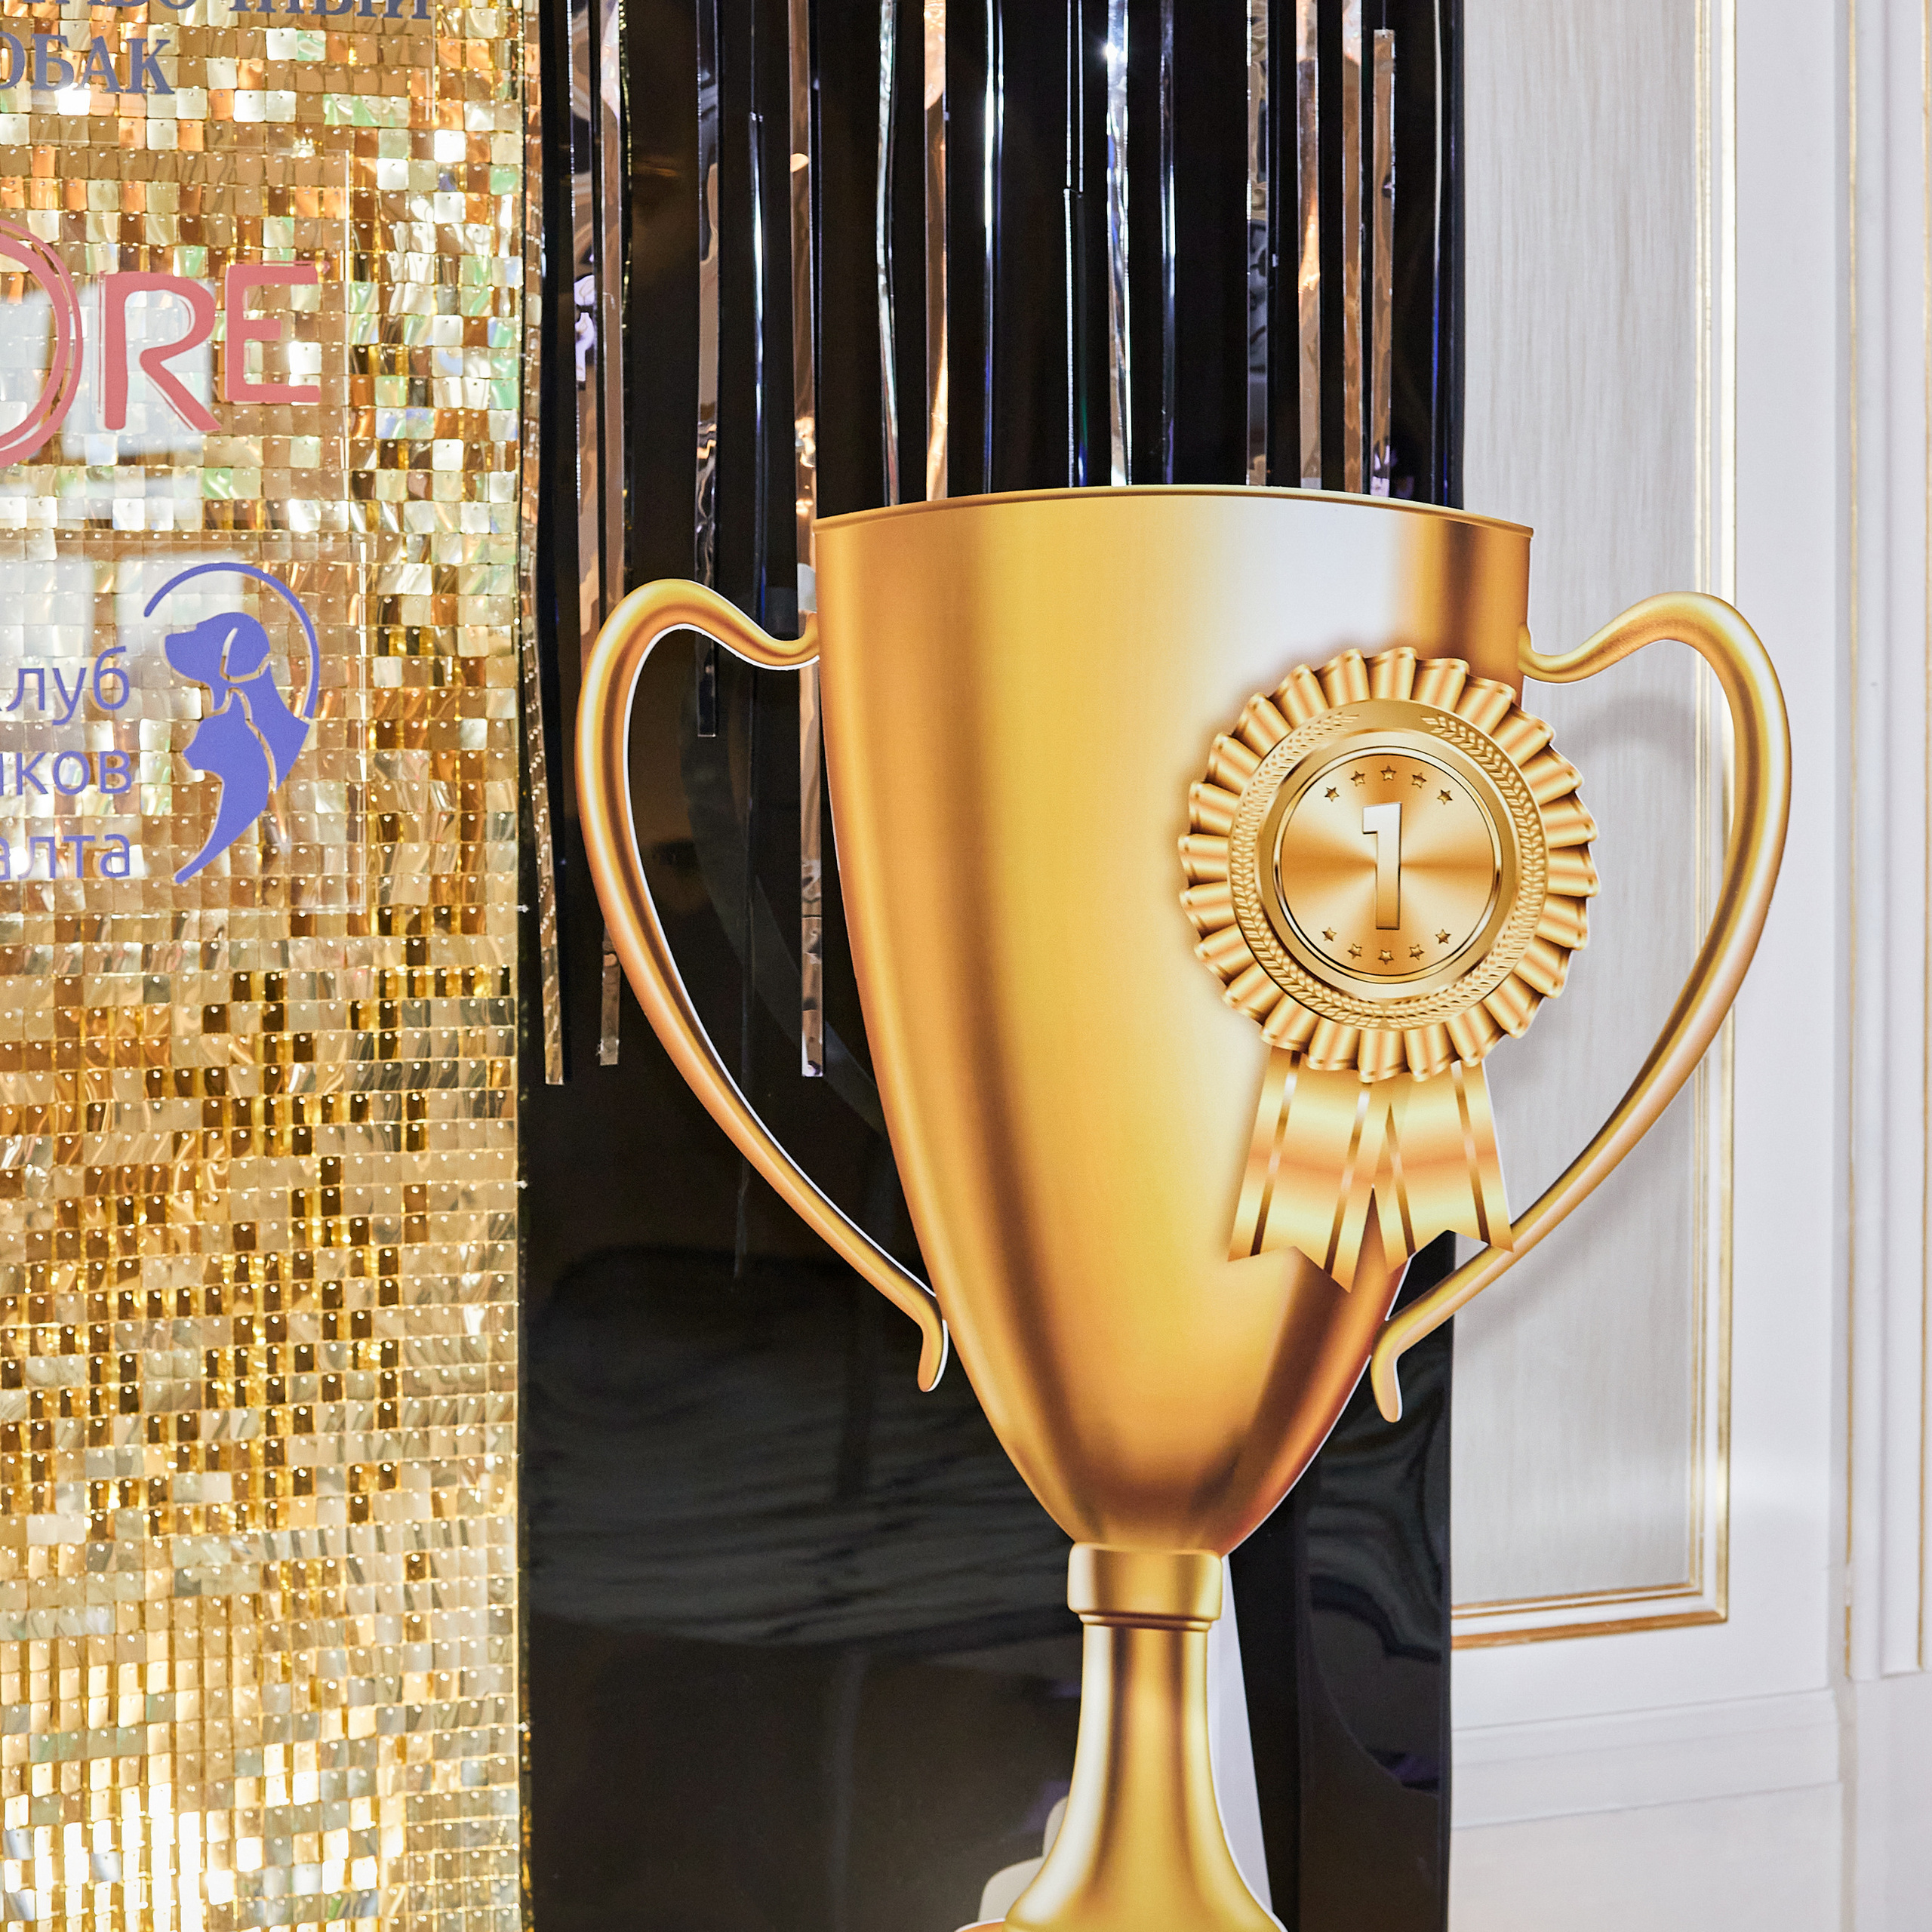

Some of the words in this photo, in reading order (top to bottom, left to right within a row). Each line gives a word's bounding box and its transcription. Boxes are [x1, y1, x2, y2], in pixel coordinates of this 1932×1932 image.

[0, 645, 130, 726] луб
[0, 749, 133, 796] ков
[1361, 801, 1402, 931] 1
